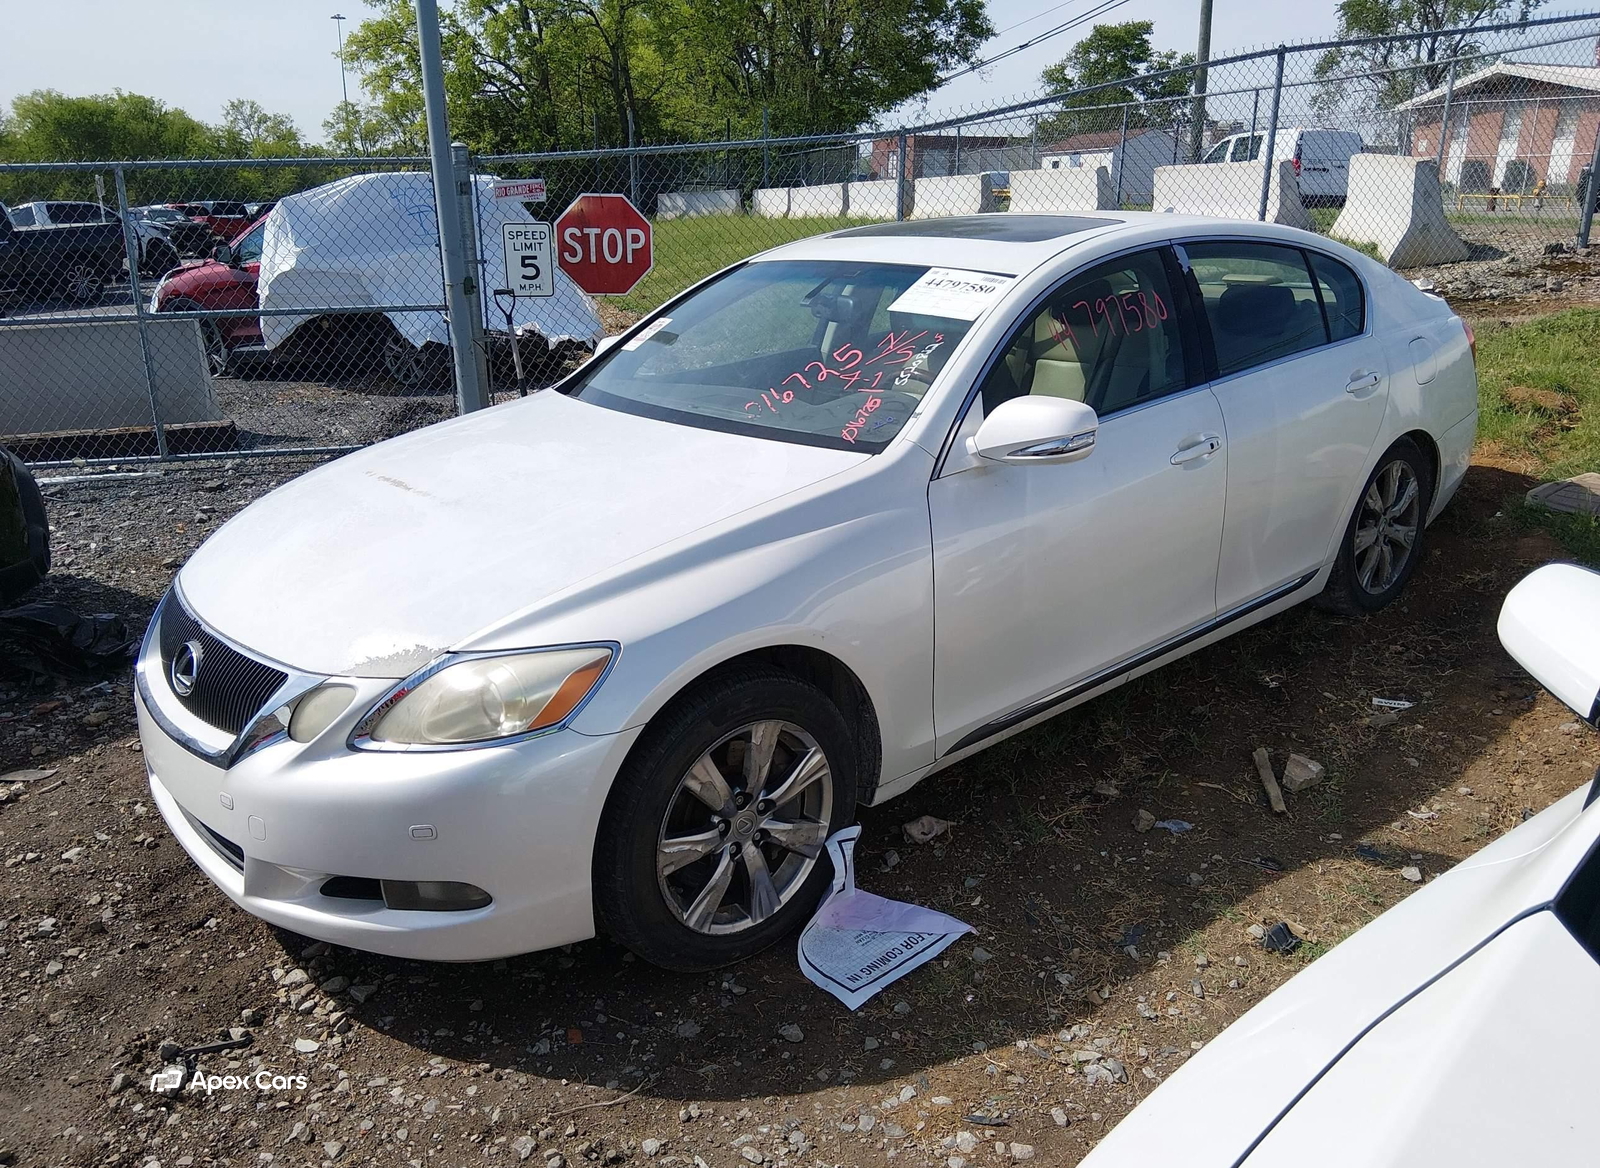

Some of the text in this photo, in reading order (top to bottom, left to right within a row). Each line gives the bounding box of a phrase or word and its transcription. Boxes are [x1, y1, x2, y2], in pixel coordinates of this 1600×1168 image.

[495, 187, 505, 197] RIO
[506, 185, 530, 195] GRANDE
[507, 230, 547, 240] SPEED
[512, 242, 544, 251] LIMIT
[563, 227, 646, 264] STOP
[520, 255, 541, 281] 5
[519, 283, 544, 291] M.P.H.
[925, 278, 996, 294] 44797580
[900, 933, 925, 950] FOR
[860, 945, 904, 976] COMING
[846, 971, 864, 984] IN
